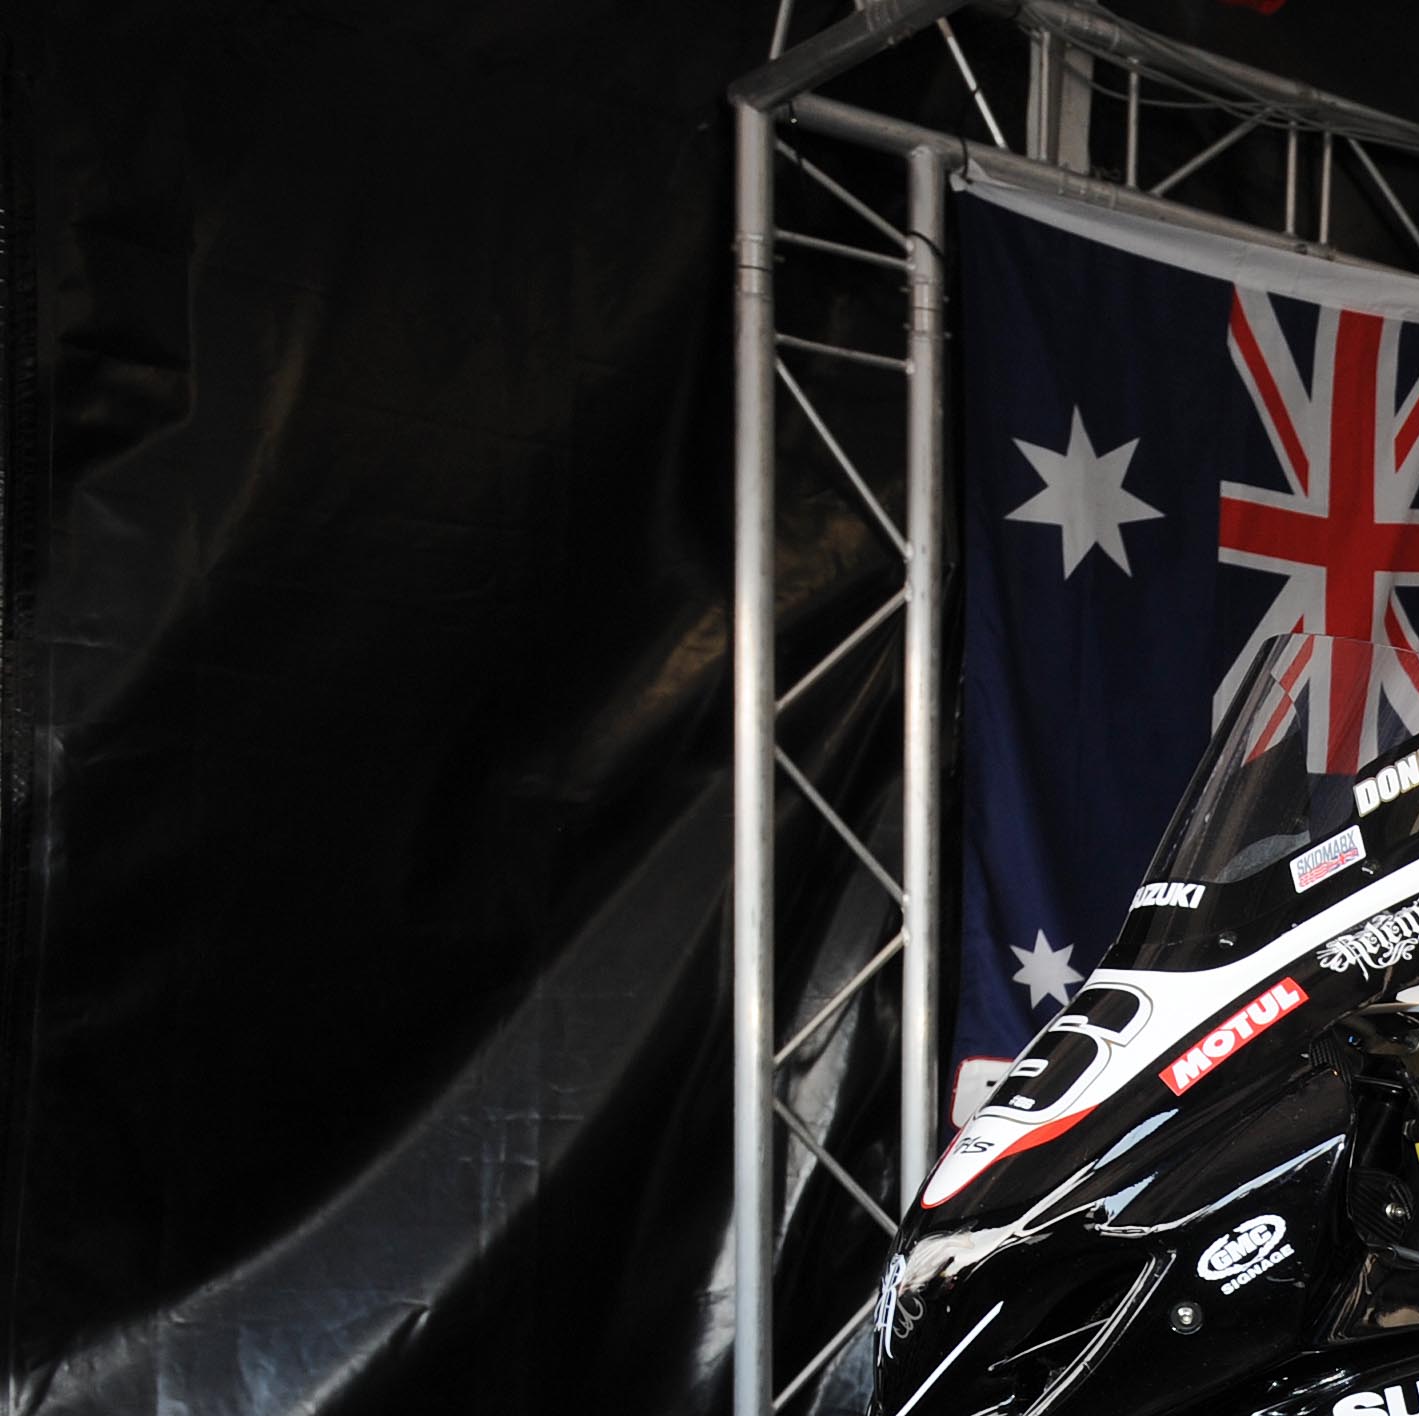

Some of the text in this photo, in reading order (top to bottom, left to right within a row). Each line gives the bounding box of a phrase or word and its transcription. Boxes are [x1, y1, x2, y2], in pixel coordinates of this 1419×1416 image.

[1171, 982, 1302, 1090] MOTUL
[1209, 1223, 1274, 1272] GMC
[1220, 1243, 1296, 1296] SIGNAGE
